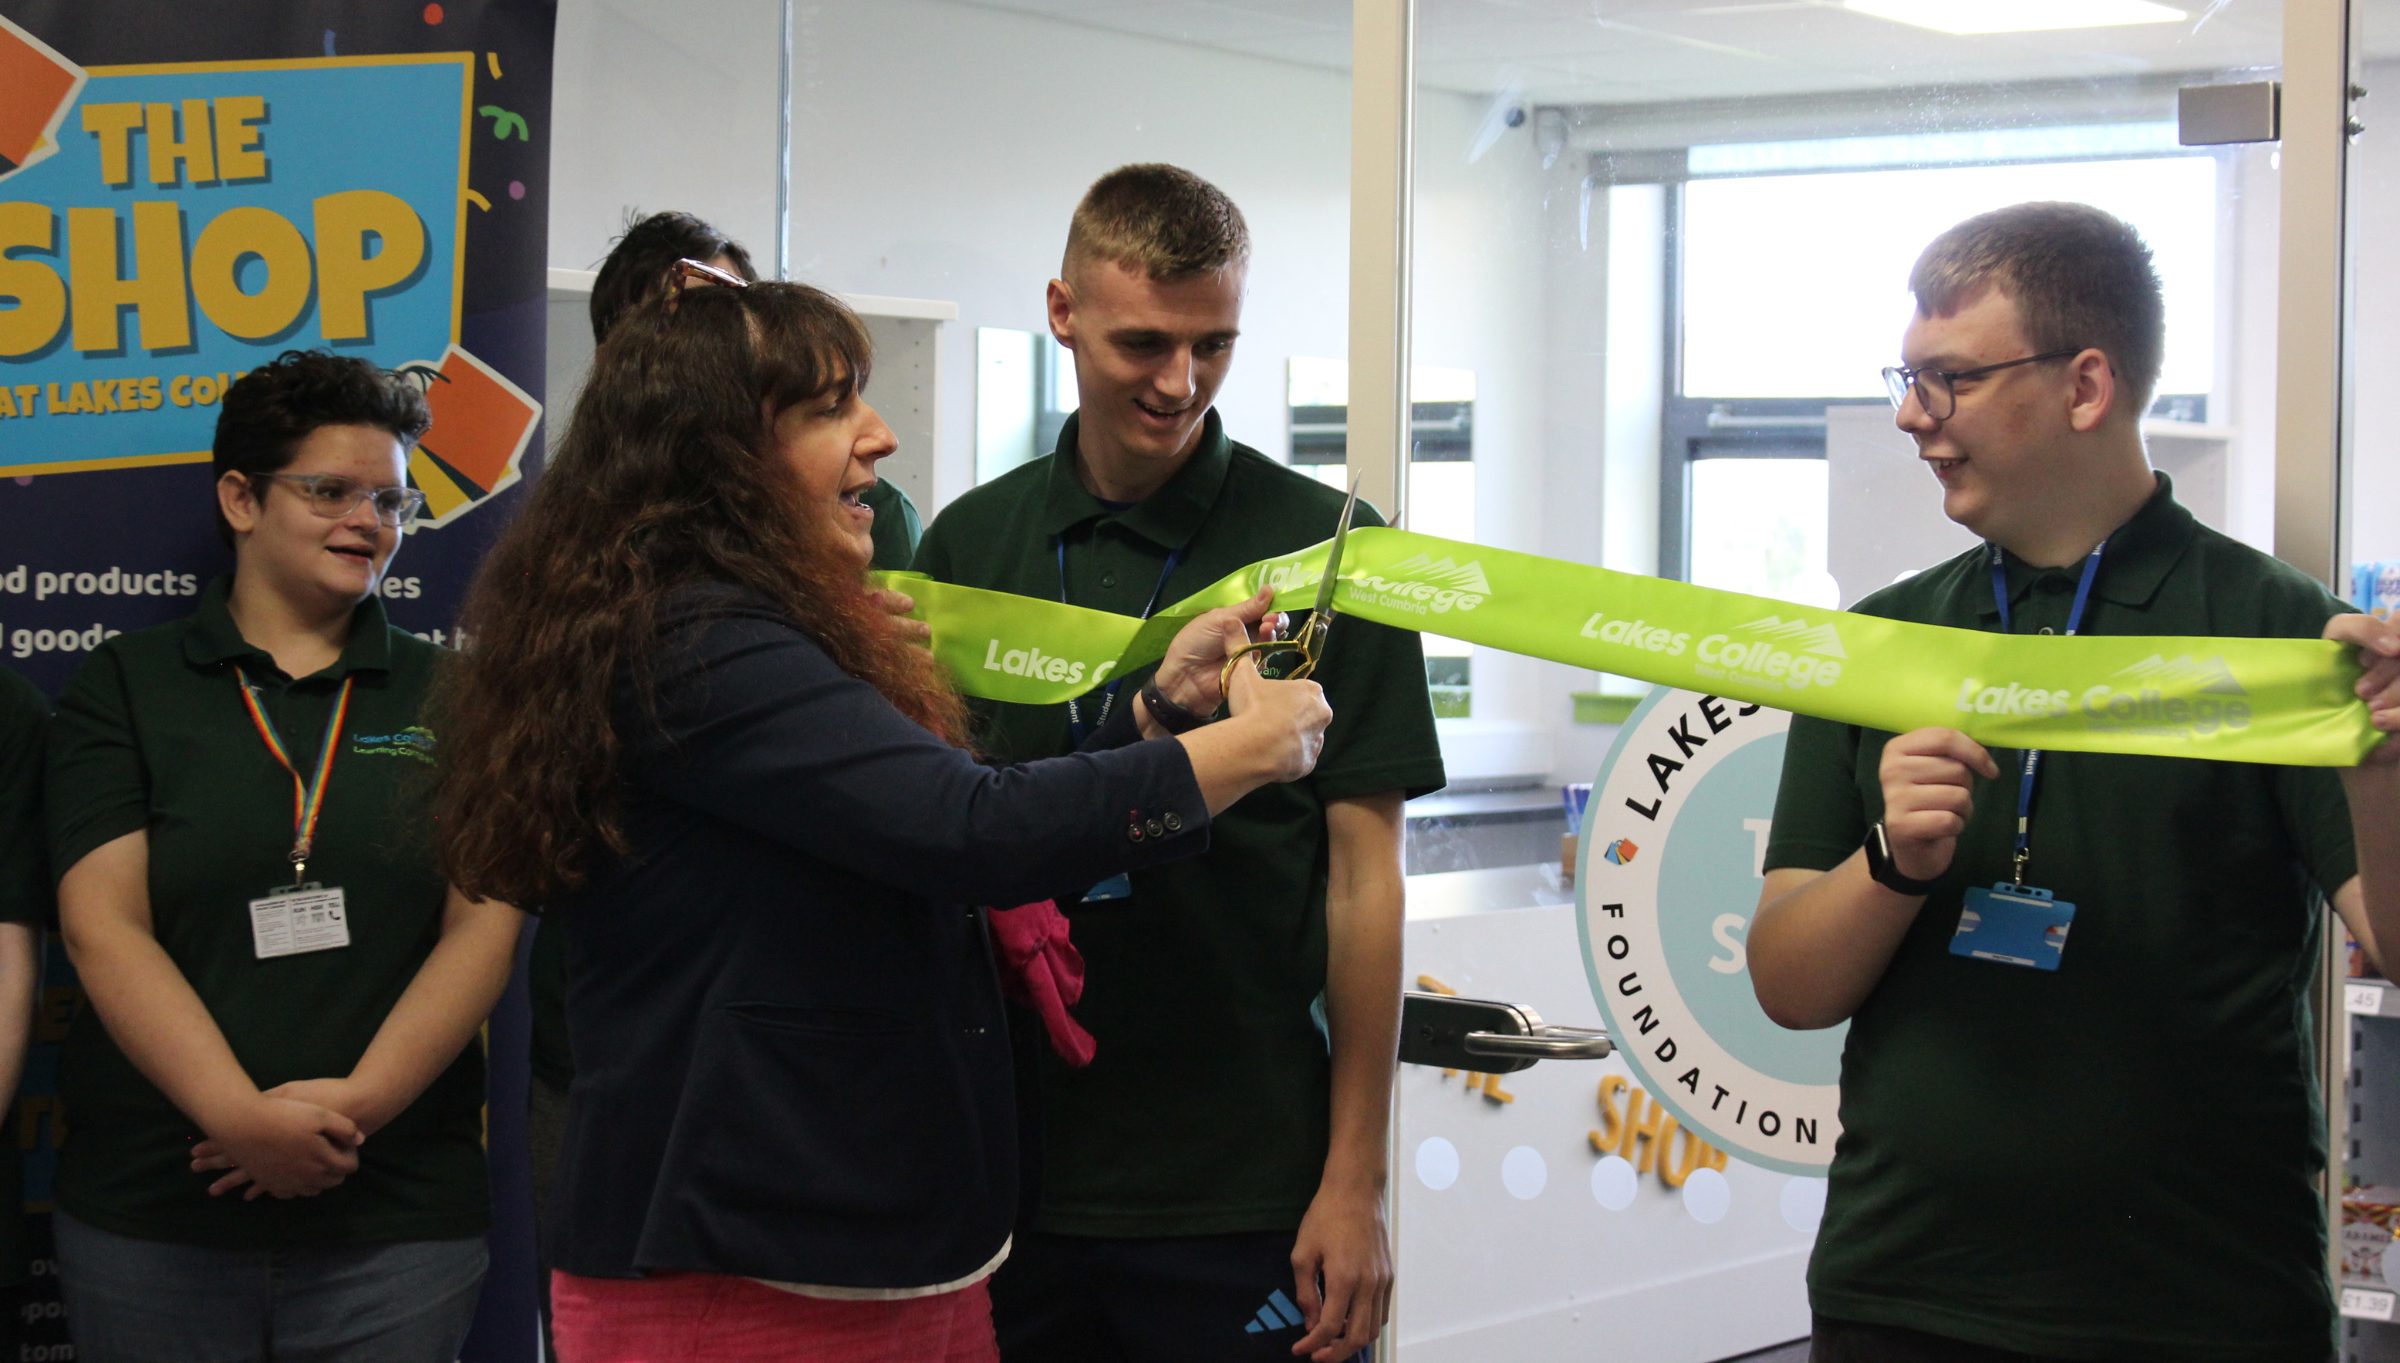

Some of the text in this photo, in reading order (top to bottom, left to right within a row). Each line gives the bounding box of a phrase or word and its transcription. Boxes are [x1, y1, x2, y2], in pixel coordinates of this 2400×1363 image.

[81, 96, 266, 185] THE
[0, 190, 427, 357] SHOP
[47, 376, 163, 414] LAKES
[169, 371, 249, 407] COL
[35, 566, 198, 601] products
[1349, 584, 1428, 616] West Cumbria
[984, 639, 1086, 685] Lakes
[1260, 667, 1282, 678] any
[1580, 611, 1843, 690] Lakes College
[1096, 692, 1115, 727] Student
[1955, 678, 2071, 718] Lakes
[2081, 685, 2252, 735] College
[1601, 903, 1818, 1145] FOUNDATION
